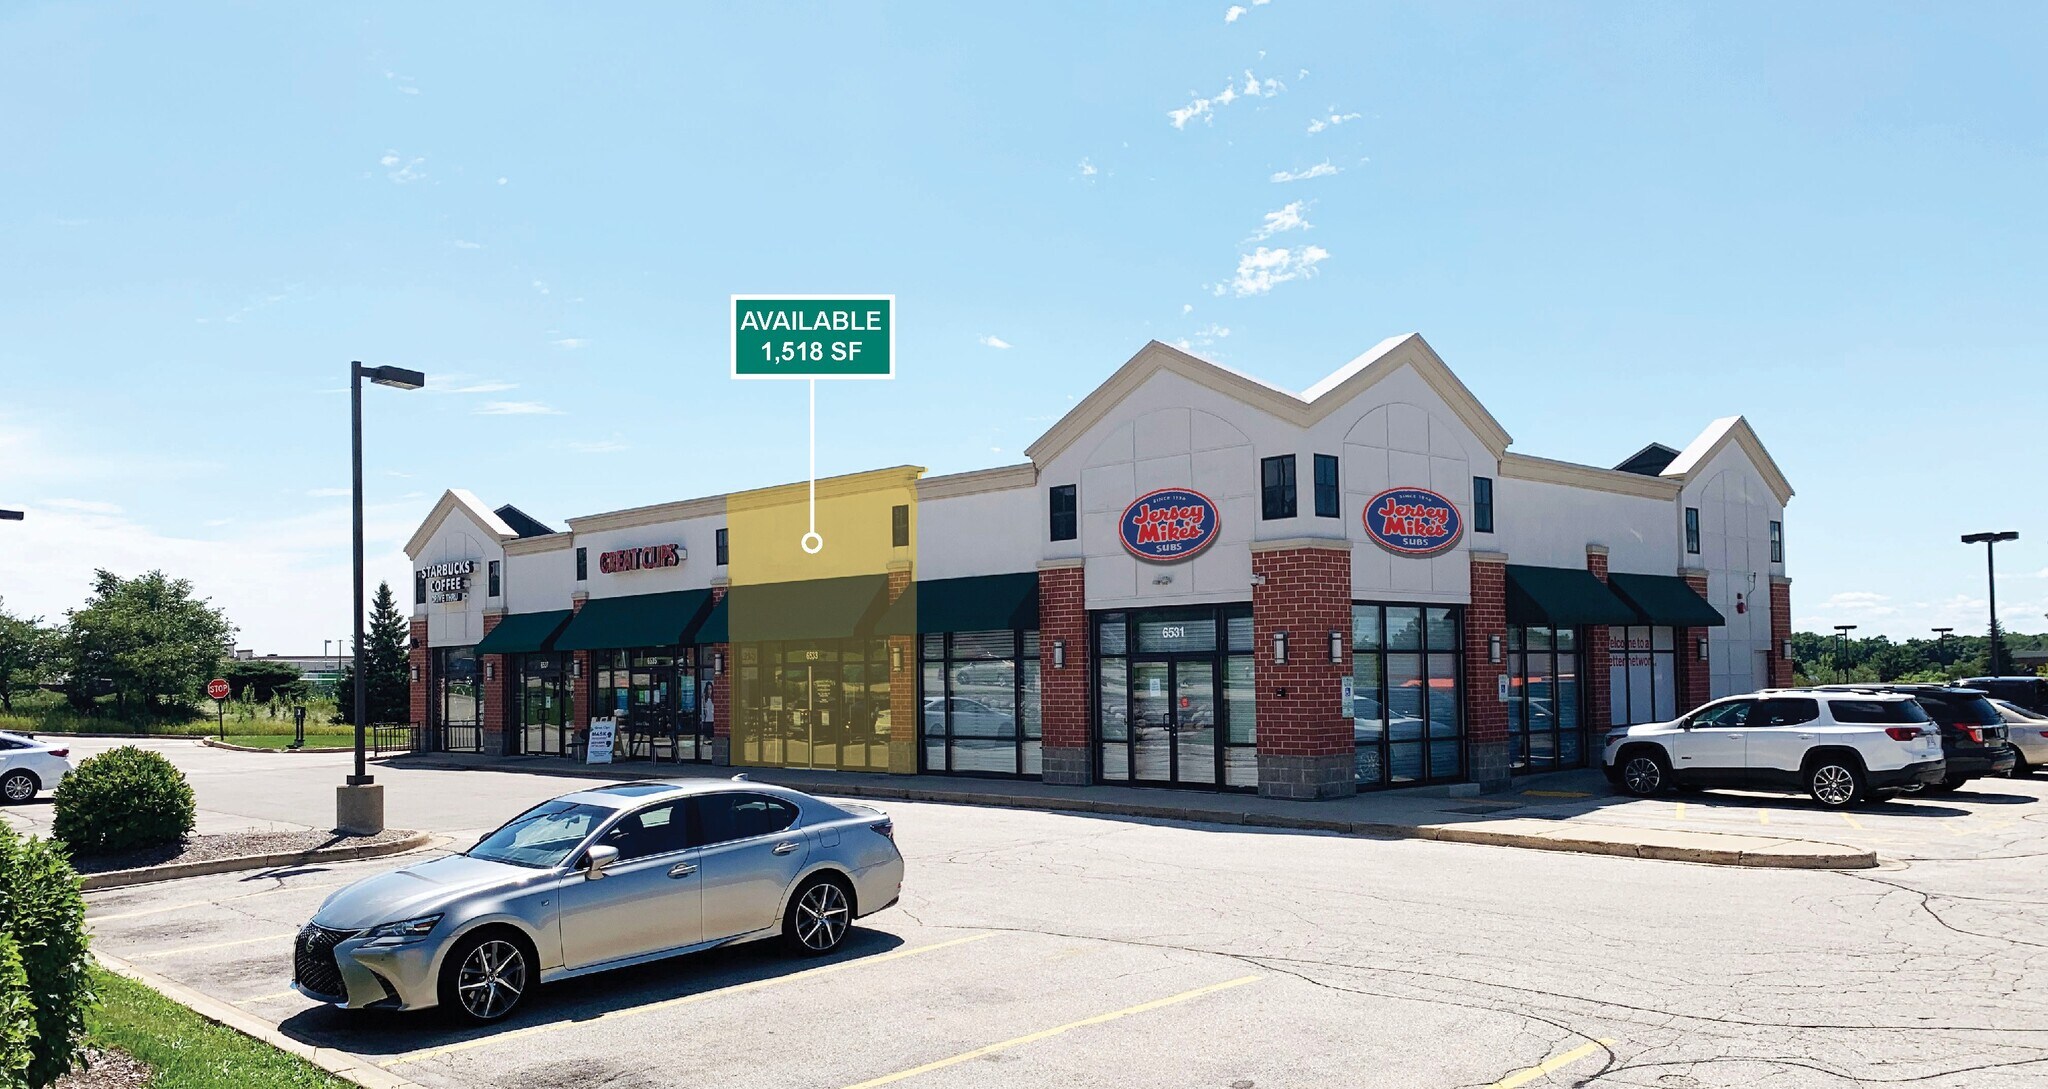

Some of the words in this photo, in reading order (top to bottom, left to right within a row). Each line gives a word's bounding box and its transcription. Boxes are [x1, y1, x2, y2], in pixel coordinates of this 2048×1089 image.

[1134, 504, 1204, 525] Jersey
[1379, 498, 1448, 524] Jersey
[1138, 520, 1204, 544] Mike's
[1383, 517, 1448, 537] Mike's
[1155, 543, 1183, 553] SUBS
[1402, 537, 1429, 547] SUBS
[599, 547, 640, 574] GREAT
[641, 543, 678, 569] CLIPS
[421, 560, 470, 579] STARBUCKS
[430, 577, 461, 592] COFFEE
[1162, 626, 1185, 639] 6531
[806, 651, 818, 660] 6533
[209, 684, 228, 694] STOP
